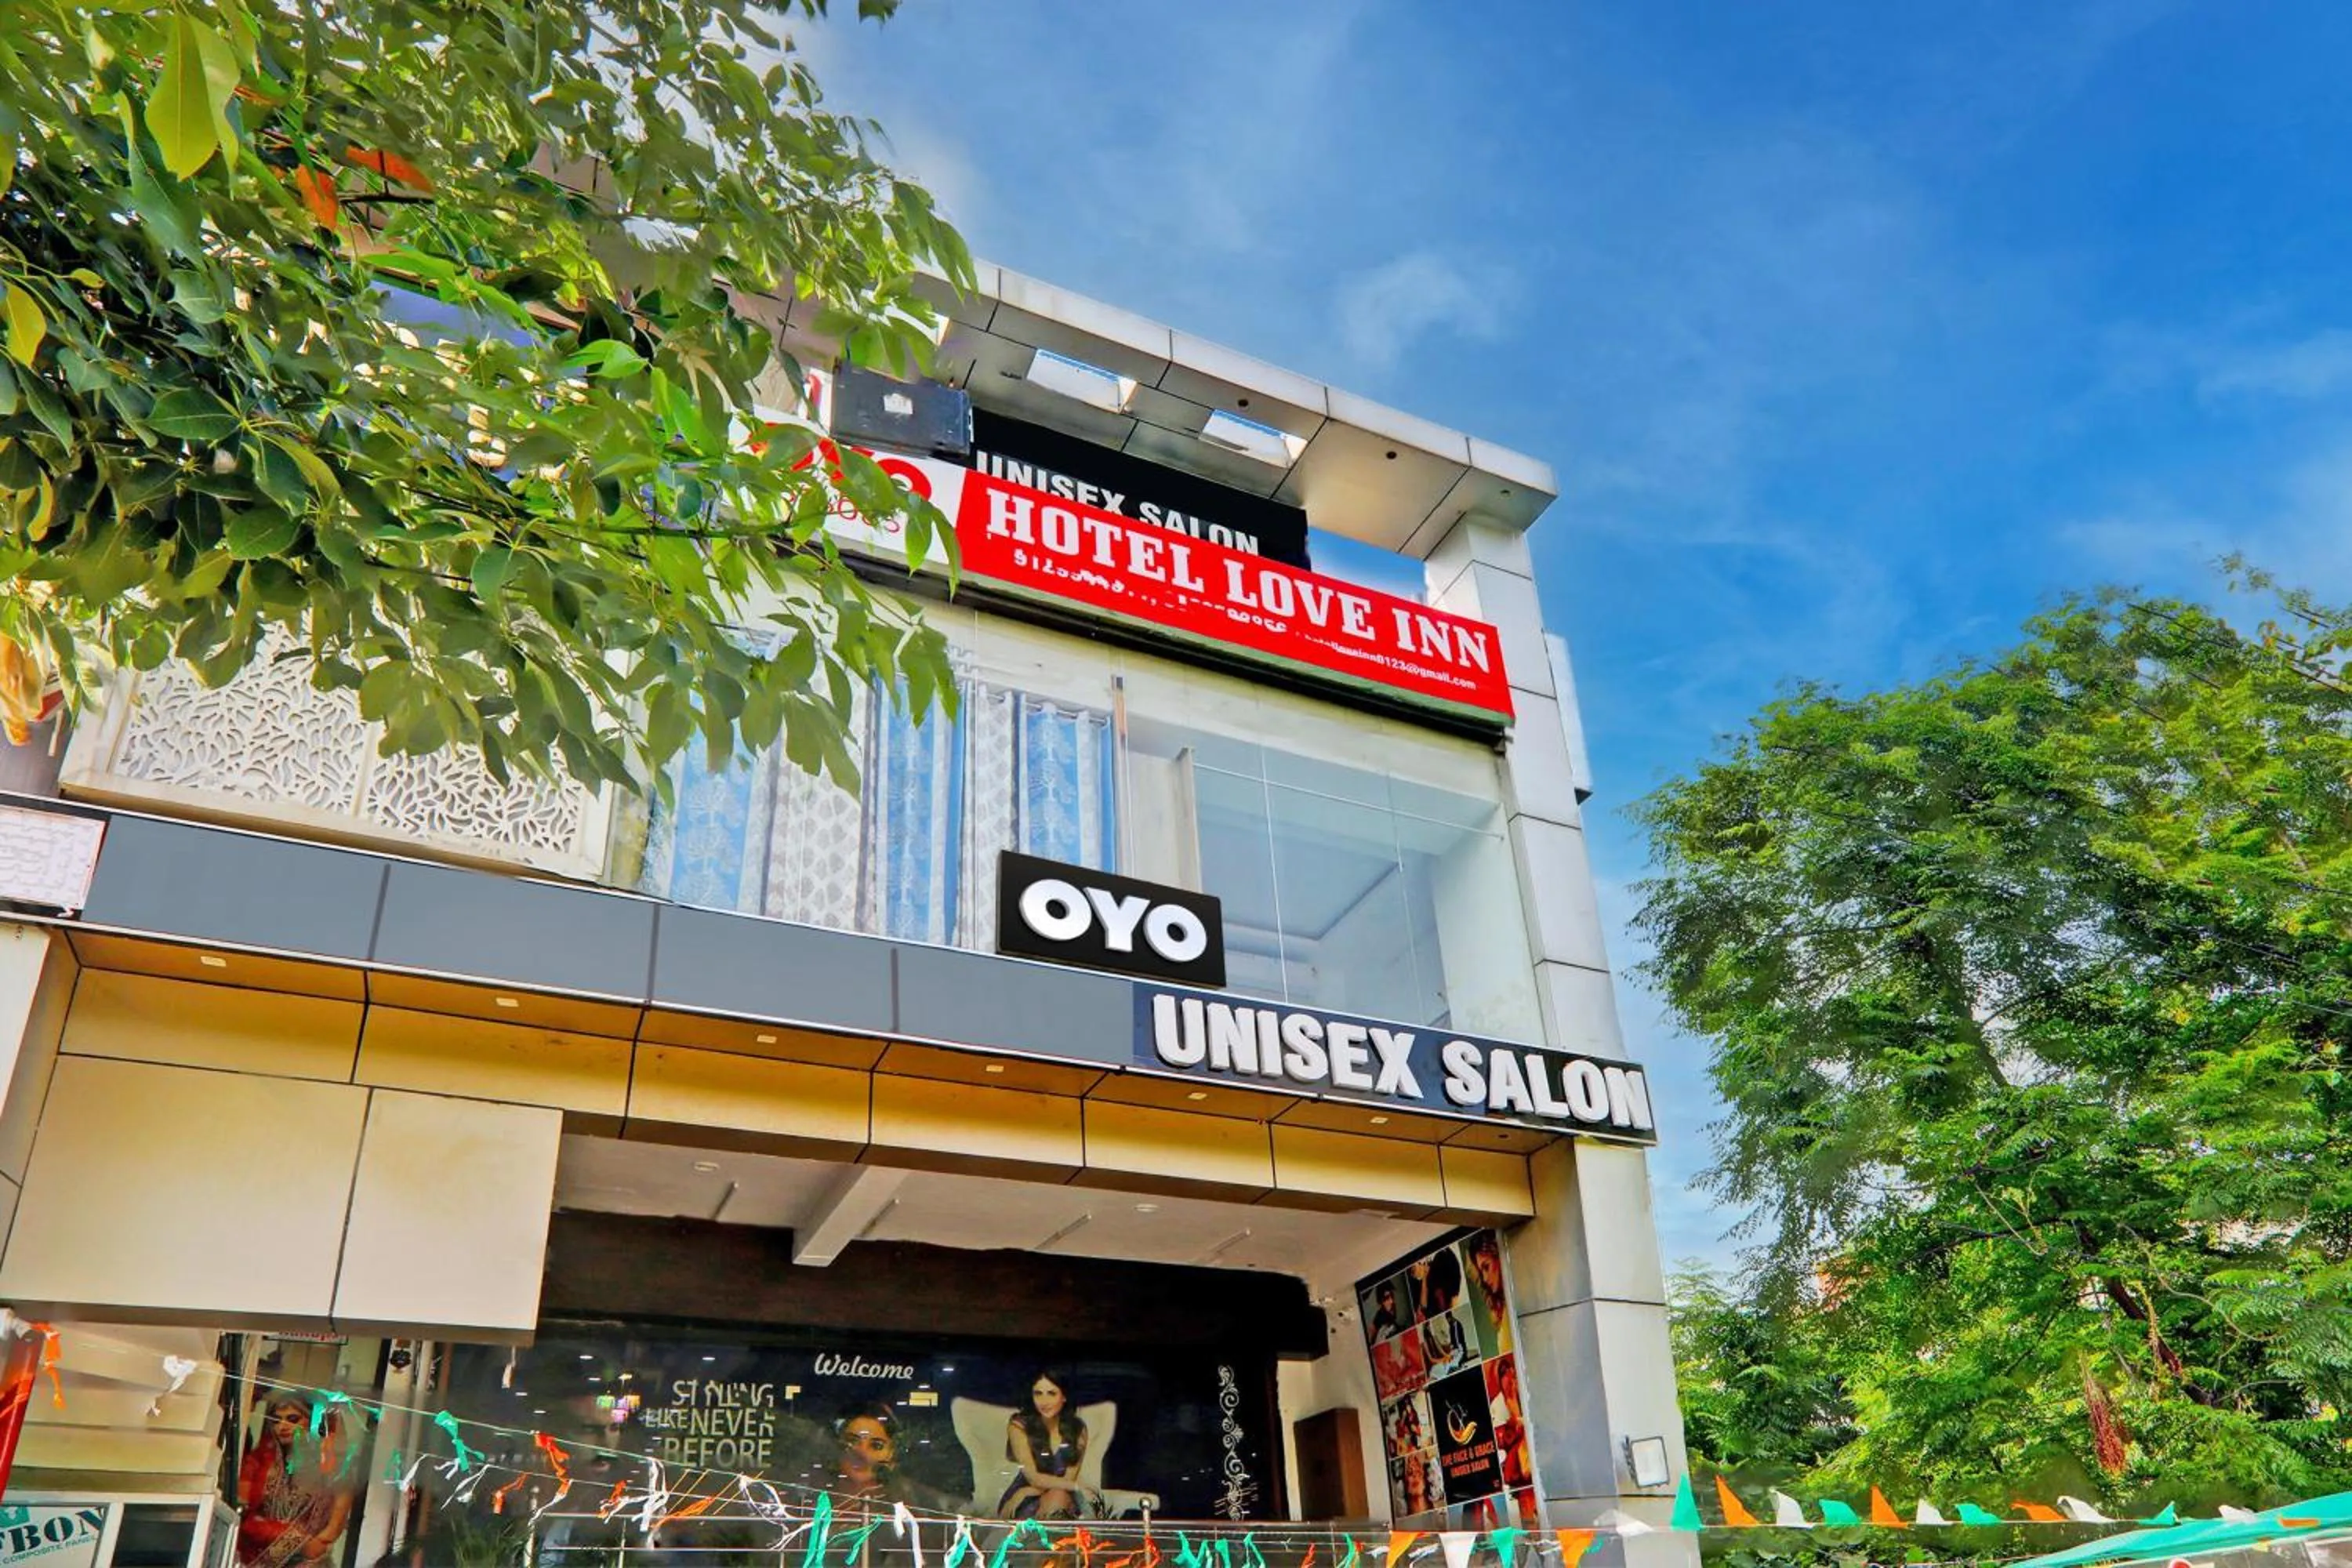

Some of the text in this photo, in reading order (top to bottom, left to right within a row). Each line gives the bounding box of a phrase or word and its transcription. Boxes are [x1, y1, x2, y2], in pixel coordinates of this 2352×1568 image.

[985, 487, 1205, 593] HOTEL
[1223, 558, 1376, 641] LOVE
[1392, 608, 1489, 673] INN
[1019, 879, 1207, 963] OYO
[1153, 993, 1653, 1130] UNISEX SALON
[814, 1352, 914, 1380] Welcome
[665, 1438, 773, 1468] BEFORE
